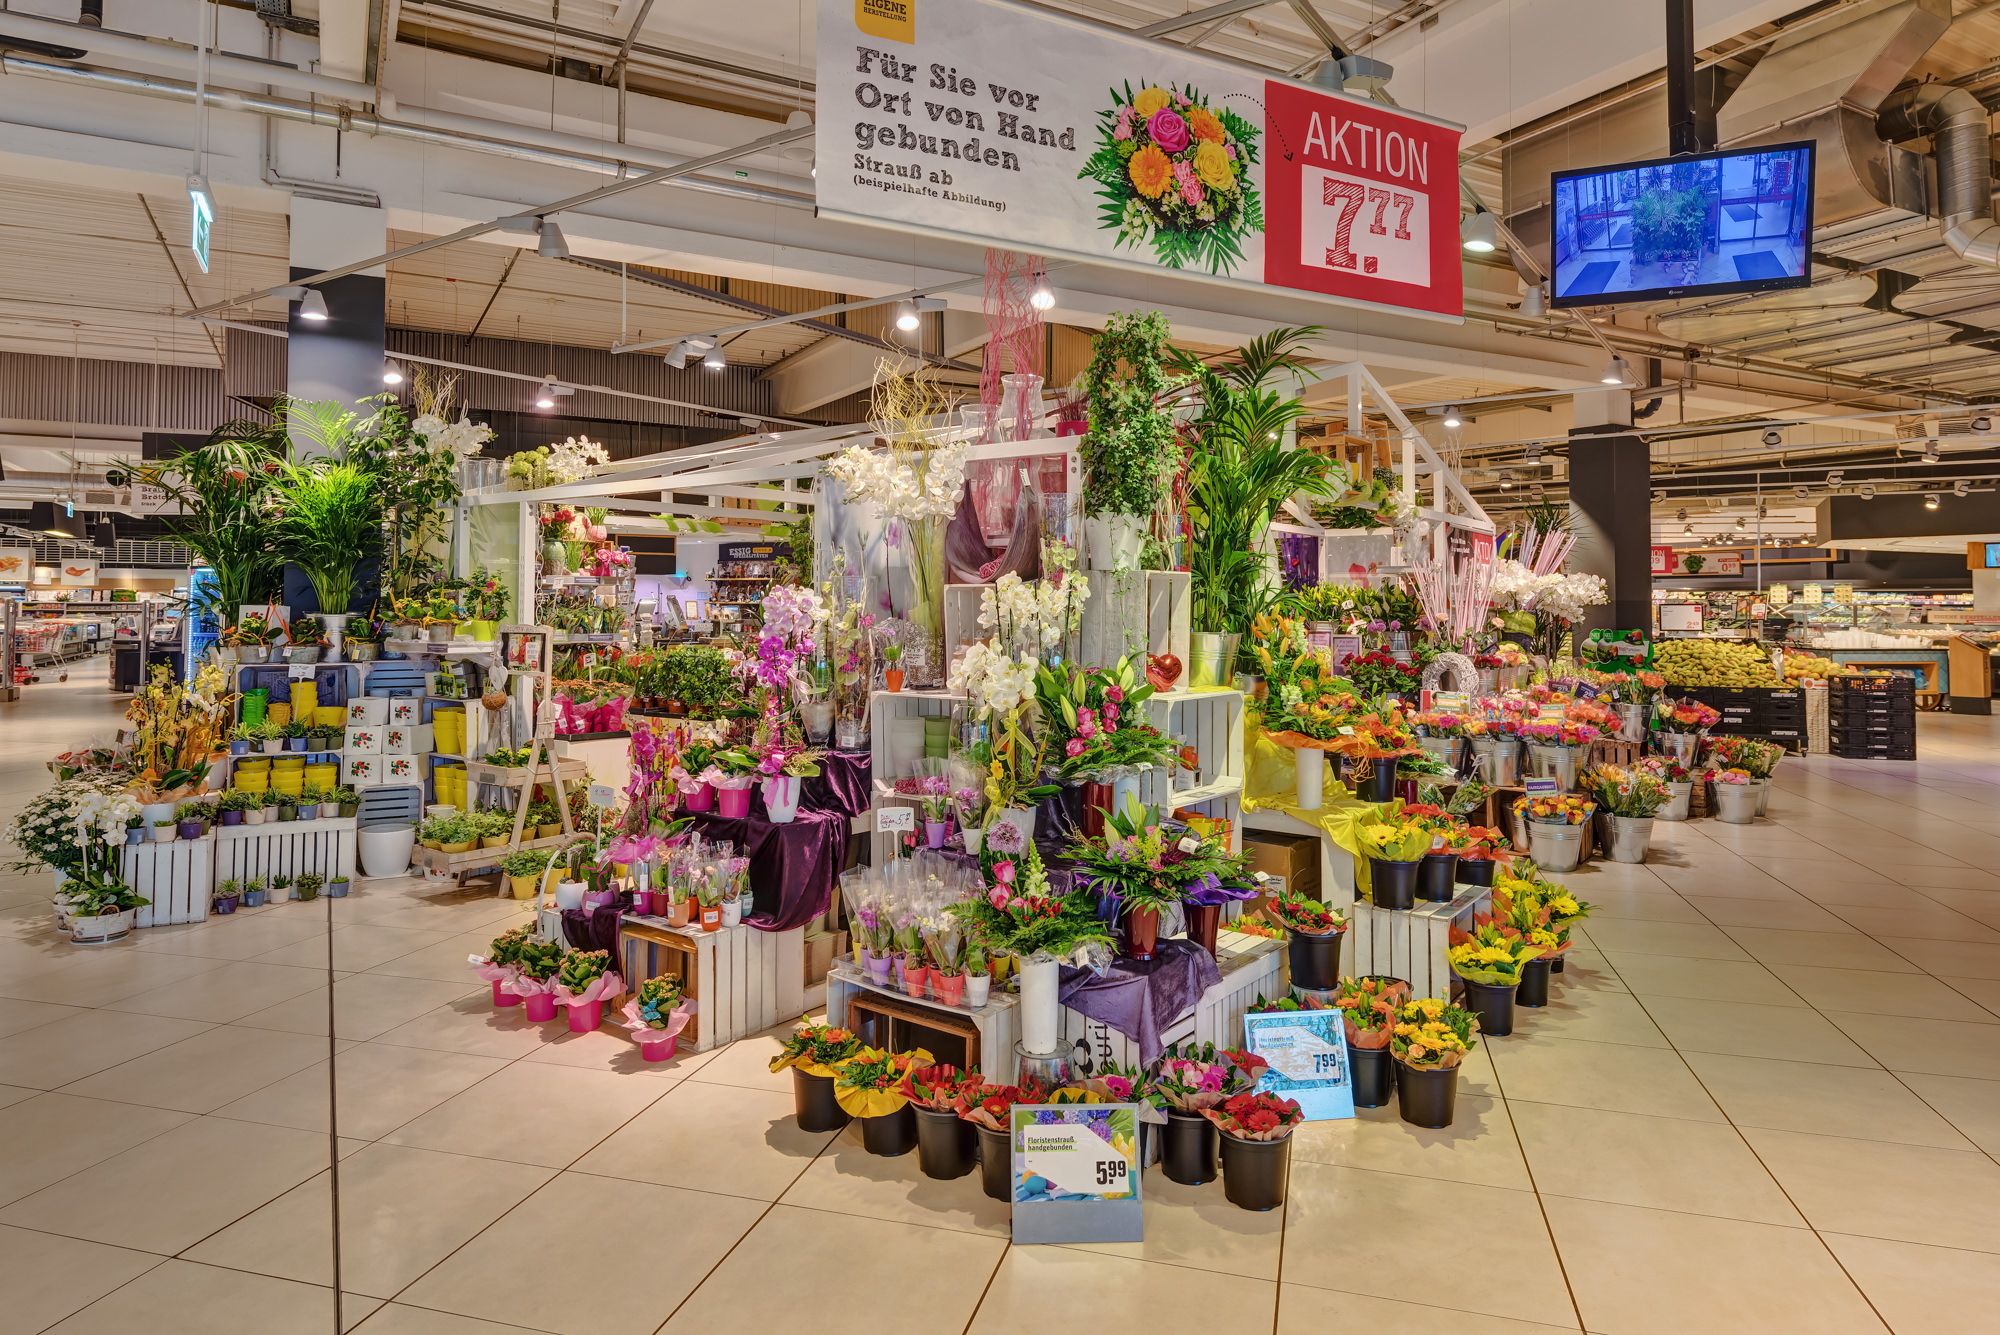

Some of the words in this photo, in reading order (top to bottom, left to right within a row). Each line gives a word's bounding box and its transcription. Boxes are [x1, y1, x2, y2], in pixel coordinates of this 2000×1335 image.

[863, 7, 907, 22] HERSTELLUNG
[864, 0, 907, 15] EIGENE
[856, 46, 917, 84] Für
[929, 63, 976, 97] Sie
[988, 83, 1040, 112] vor
[855, 82, 911, 116] Ort
[924, 101, 985, 132] von
[998, 111, 1076, 151] Hand
[855, 121, 1021, 172] gebunden
[1303, 111, 1428, 185] AKTION
[854, 153, 922, 180] Strauß
[929, 169, 953, 186] ab
[853, 175, 938, 198] (beispielhafte
[942, 190, 1007, 212] Abbildung)
[729, 547, 751, 556] ESSIG
[1027, 1136, 1074, 1144] Floristenstrauß
[1027, 1144, 1073, 1152] handgebunden
